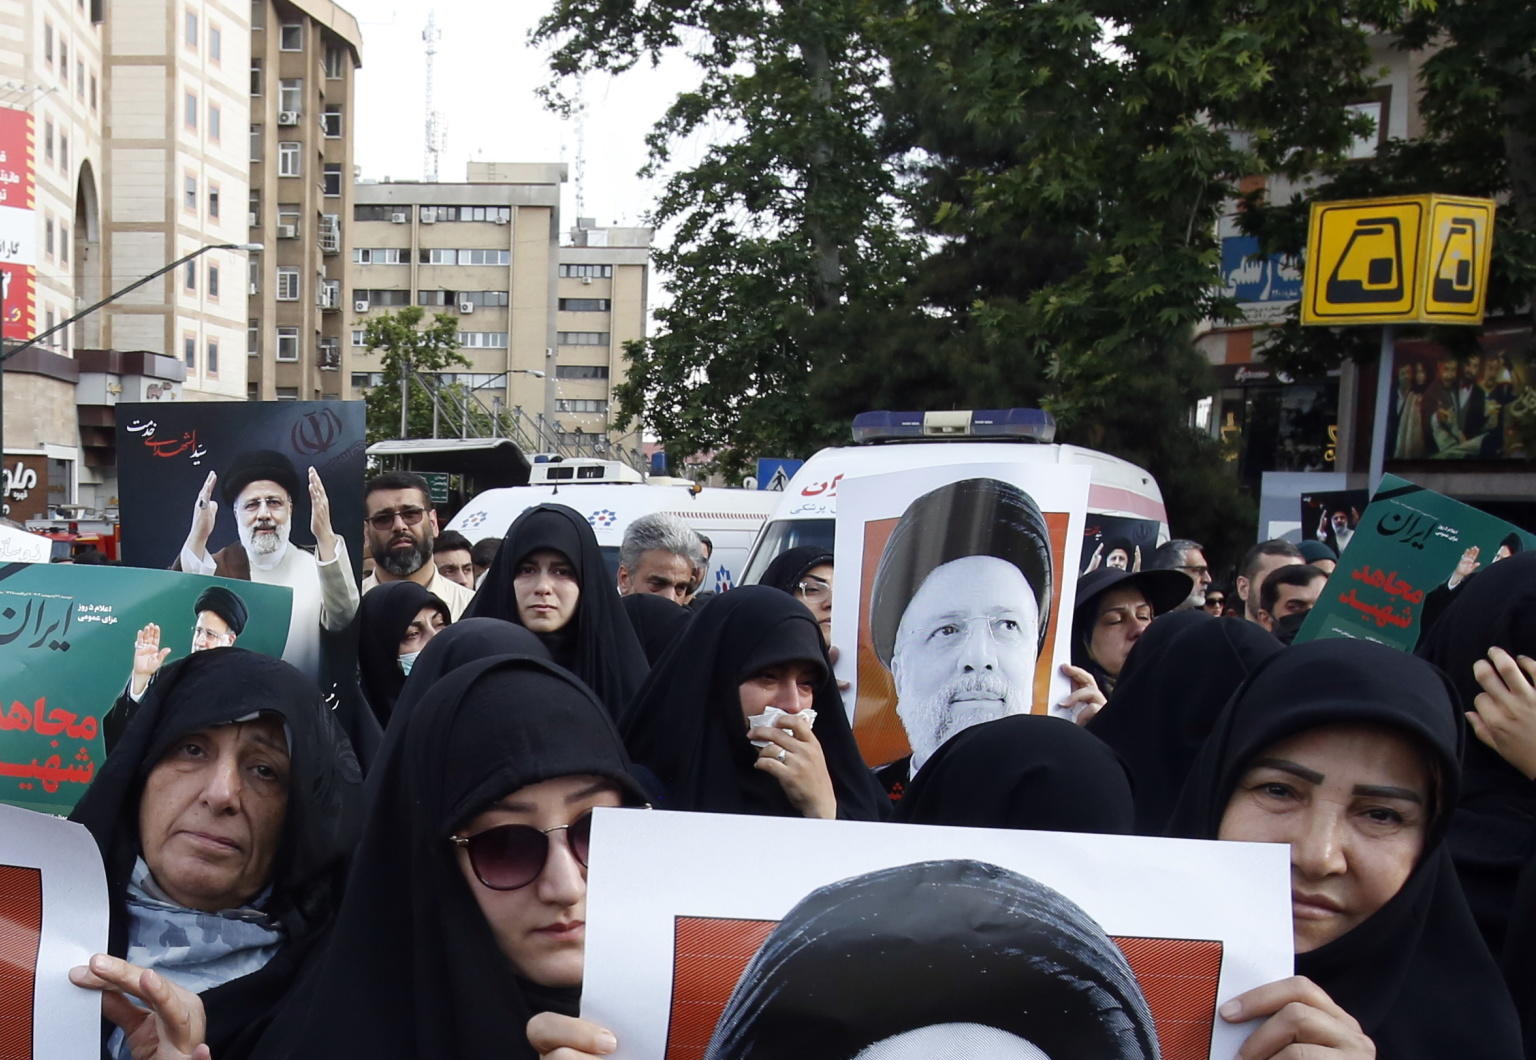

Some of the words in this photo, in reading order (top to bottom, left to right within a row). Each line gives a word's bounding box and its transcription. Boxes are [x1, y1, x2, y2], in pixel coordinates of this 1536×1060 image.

[126, 419, 158, 437] خدمت
[1376, 511, 1437, 550] ایران
[1351, 565, 1425, 604] مجاهد
[1339, 589, 1413, 628] شهید
